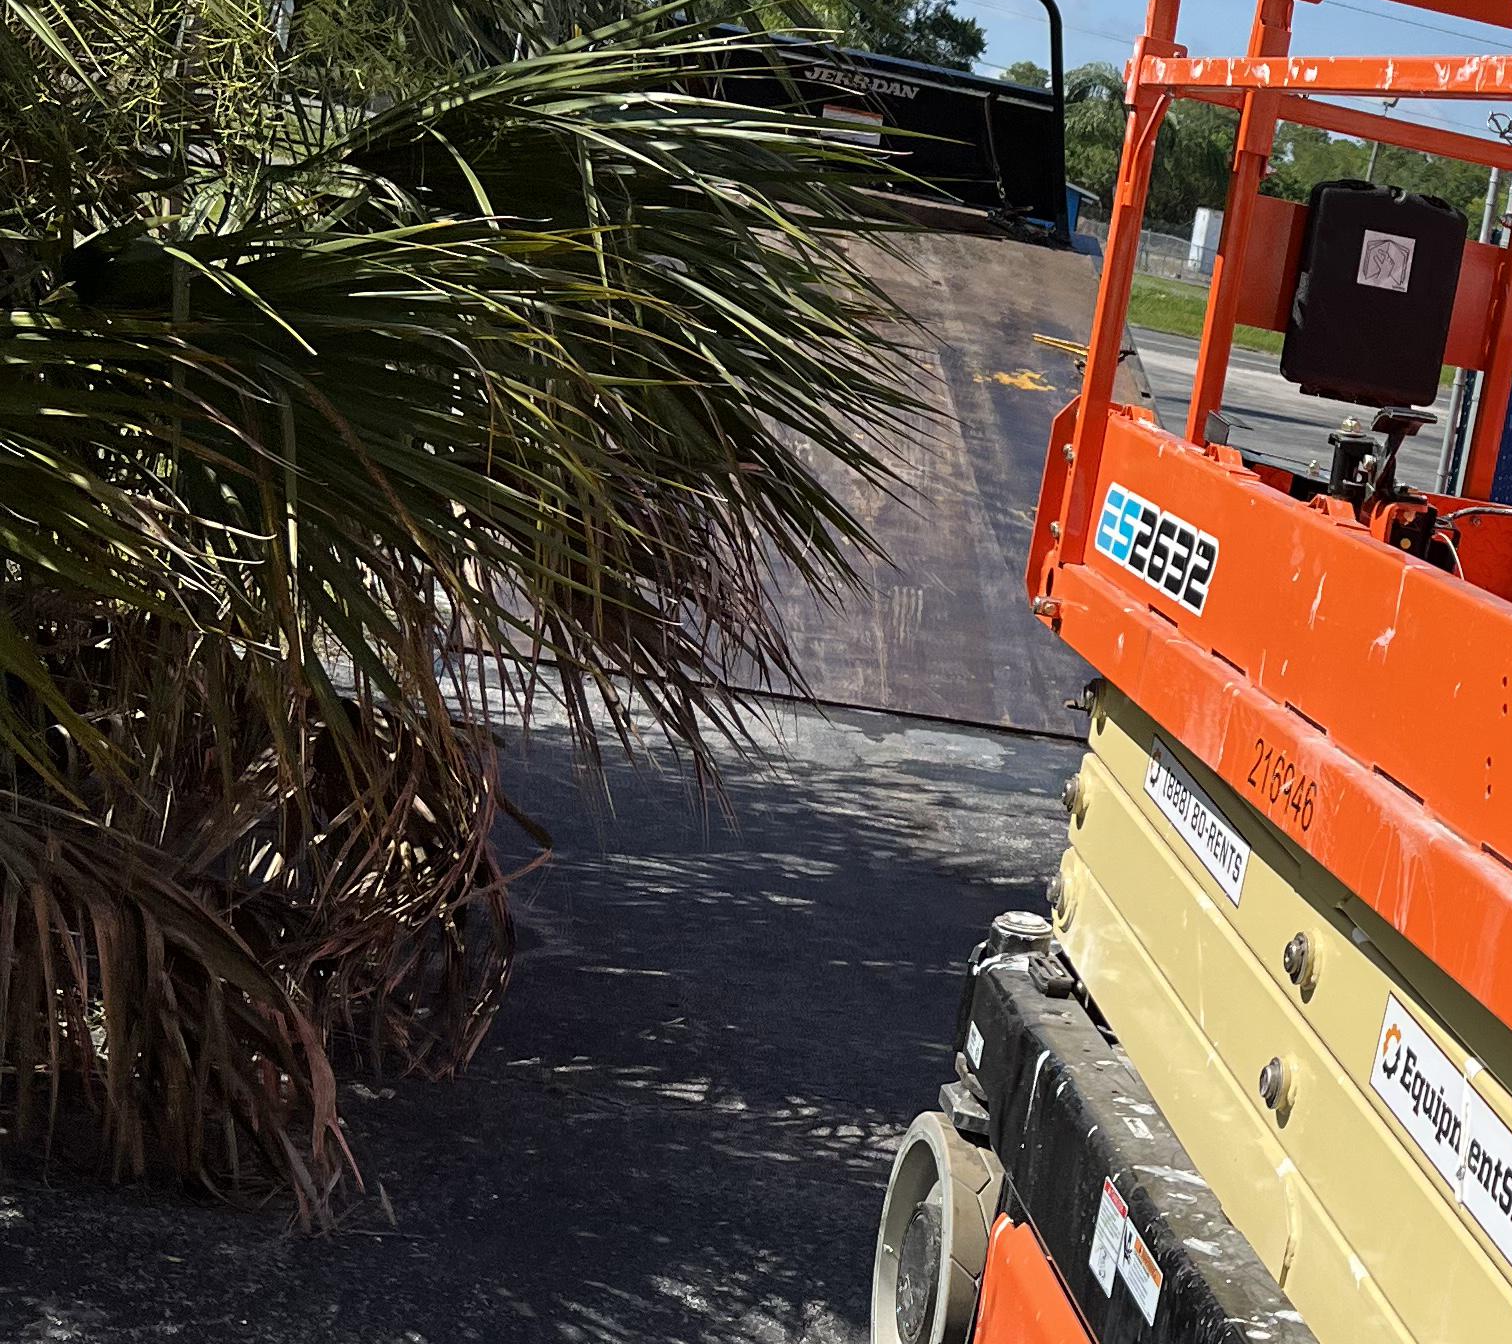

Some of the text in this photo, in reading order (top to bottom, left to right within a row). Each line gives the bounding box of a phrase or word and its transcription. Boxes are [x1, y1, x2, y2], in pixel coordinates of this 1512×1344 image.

[1096, 487, 1218, 613] ES2632
[1161, 766, 1243, 884] (888) 80-RENTS
[1247, 738, 1317, 833] 216946
